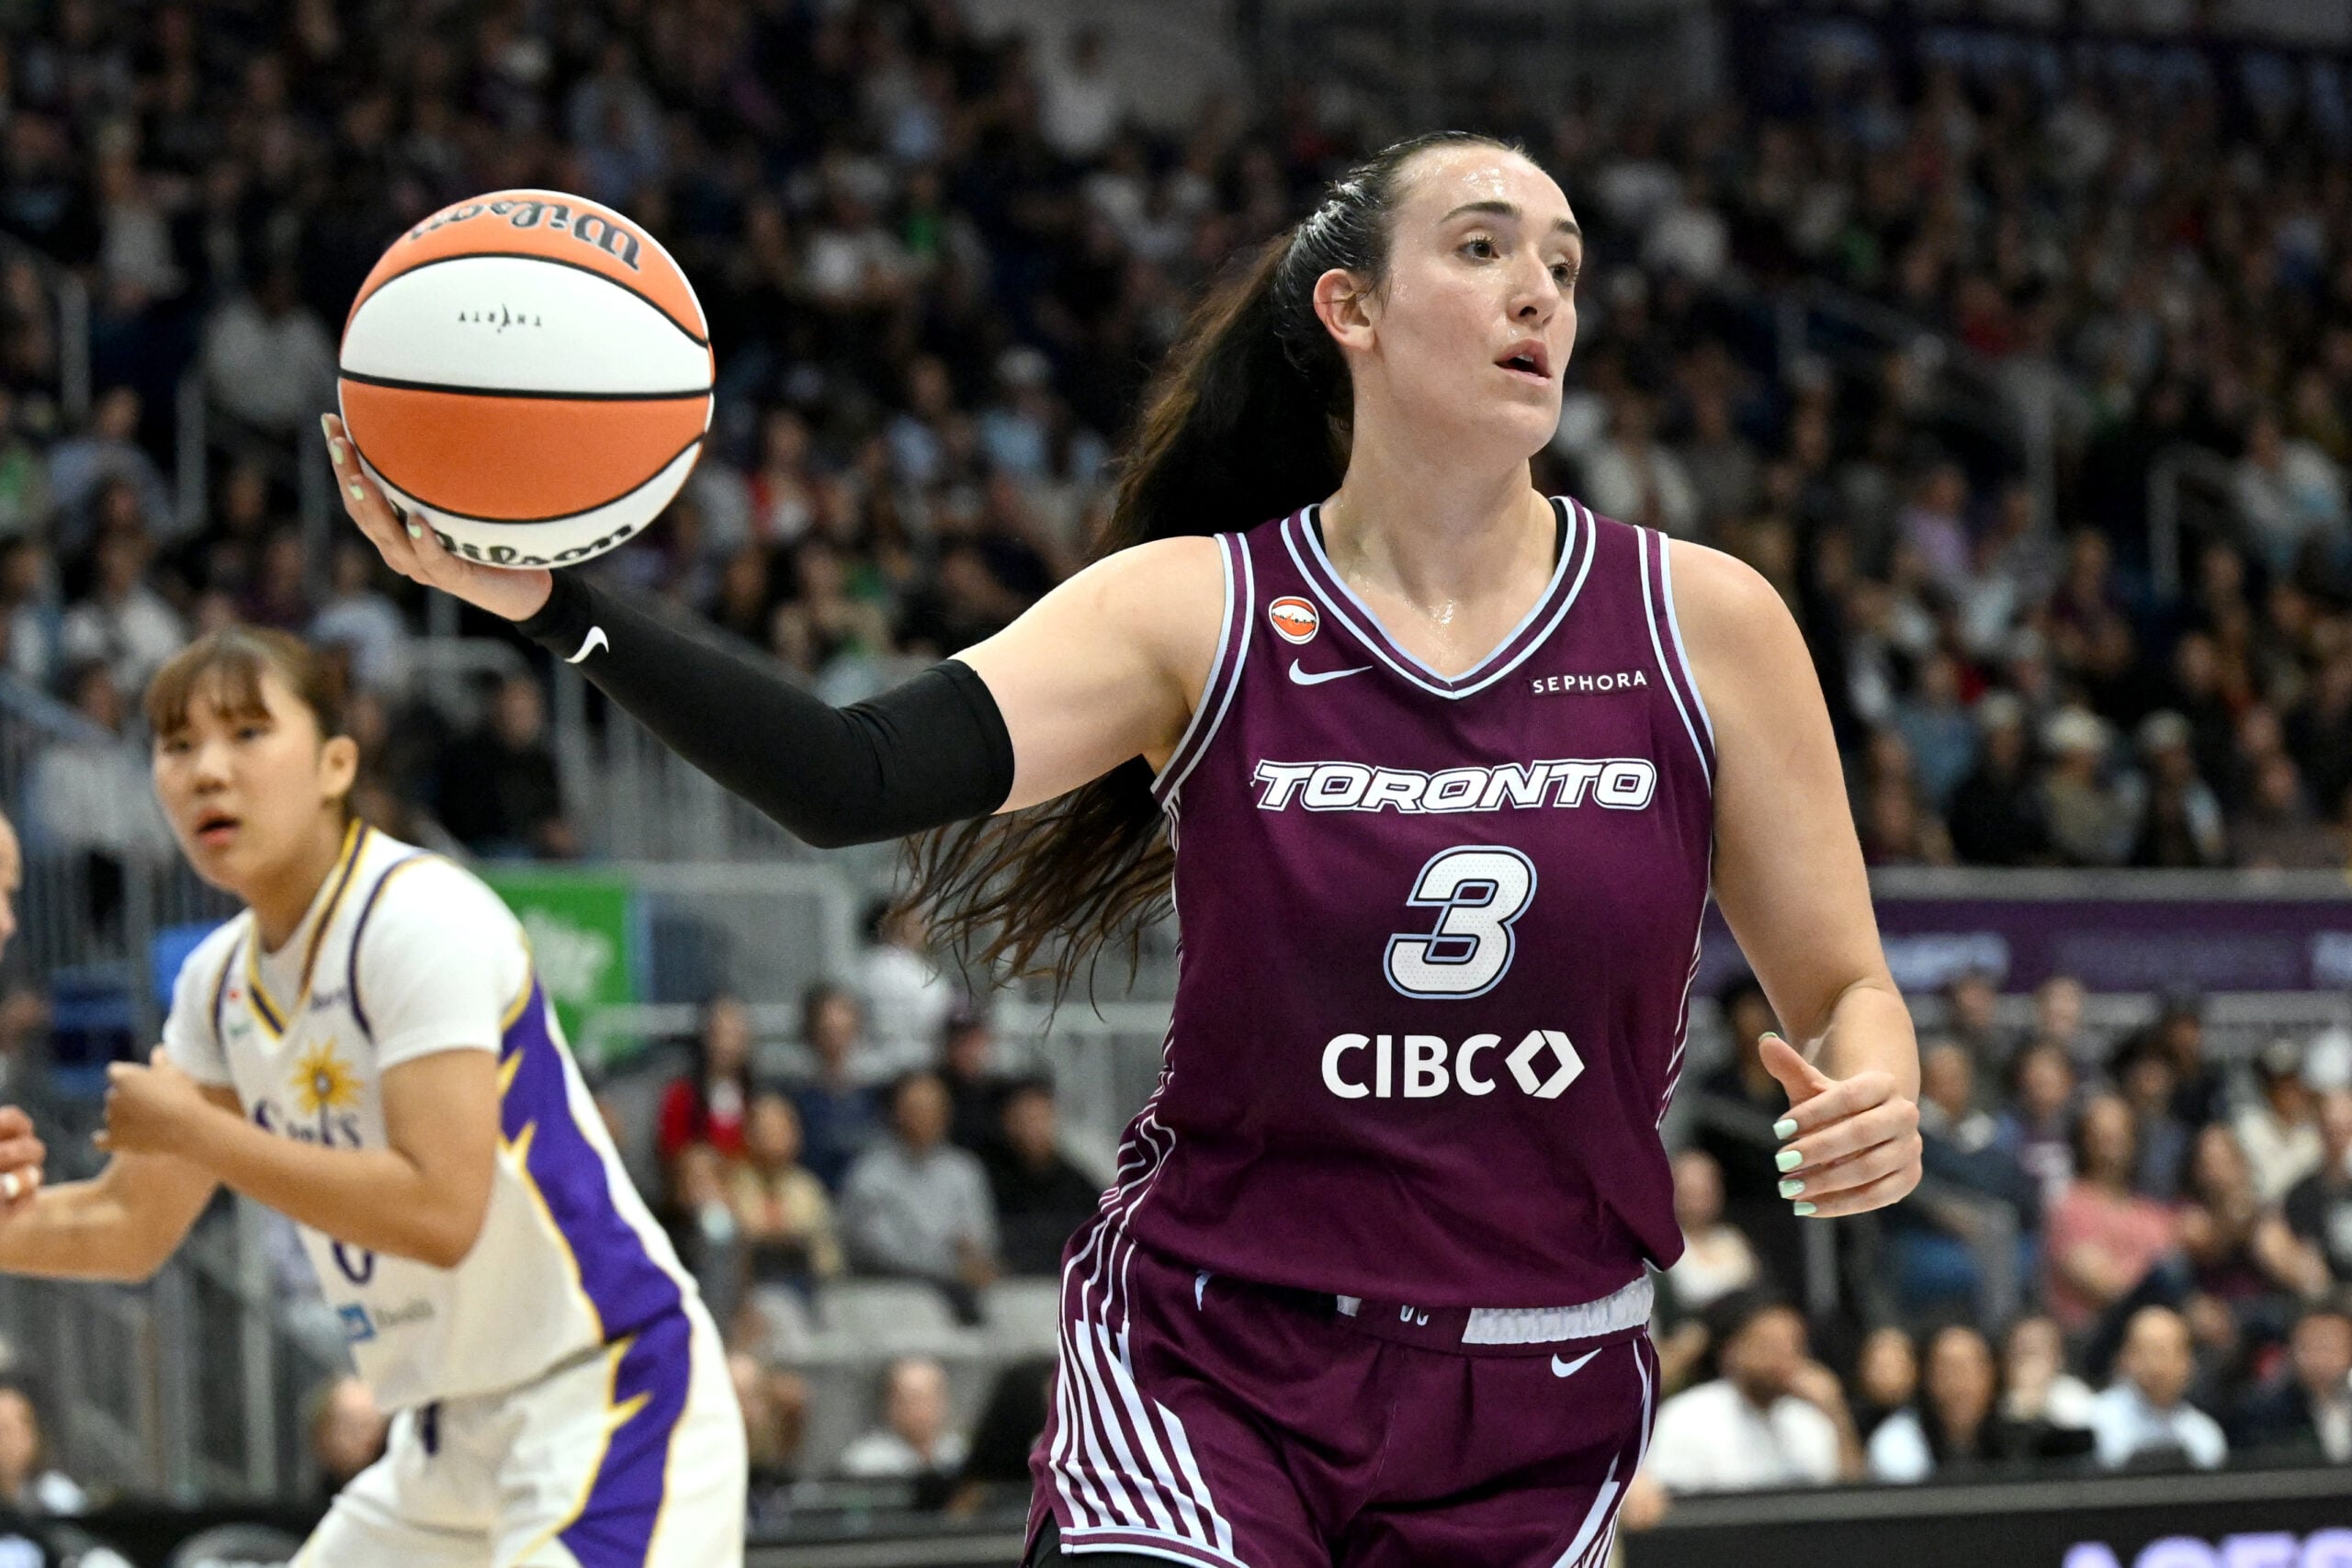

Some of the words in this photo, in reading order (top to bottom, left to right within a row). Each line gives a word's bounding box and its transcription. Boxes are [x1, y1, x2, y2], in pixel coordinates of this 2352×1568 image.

[412, 200, 639, 270] Wilson
[1532, 671, 1647, 694] SEPHORA
[1255, 758, 1657, 813] TORONTO
[1384, 845, 1537, 999] 3
[1321, 1033, 1501, 1099] CIBC
